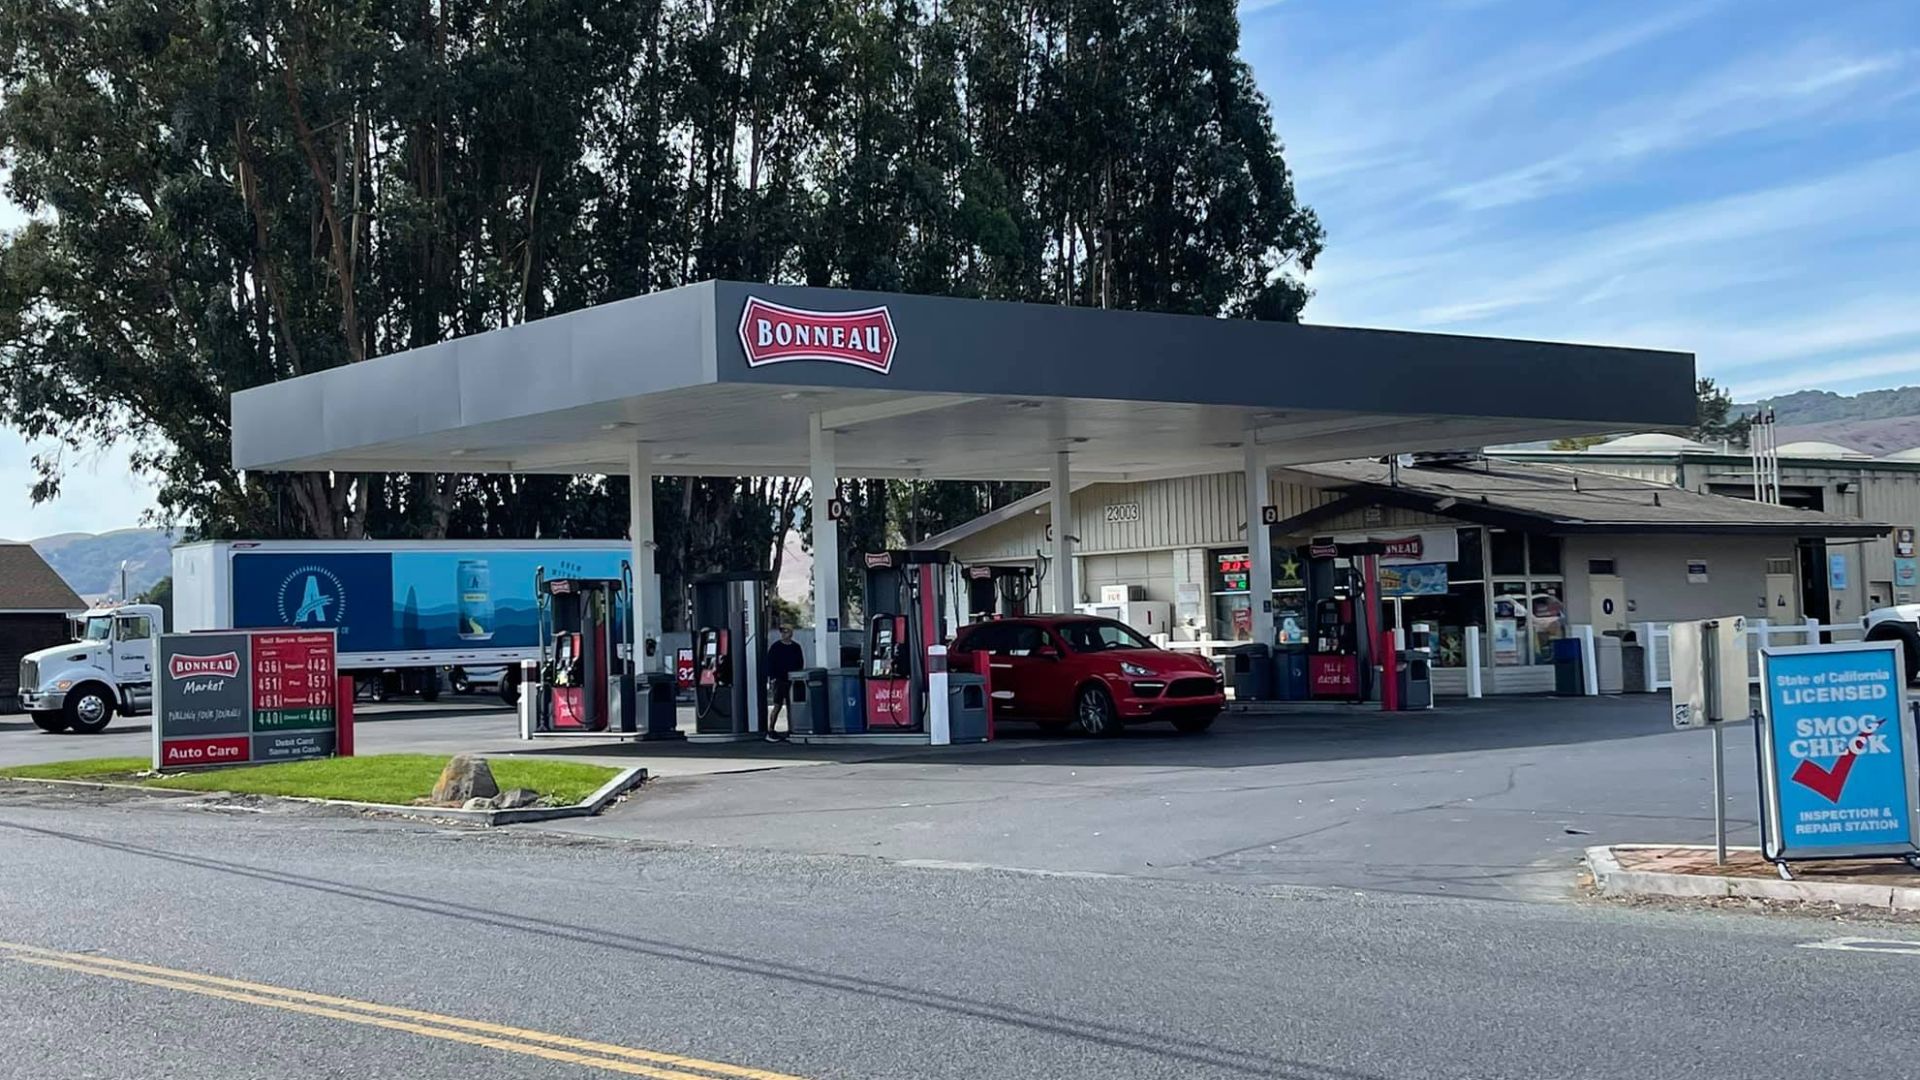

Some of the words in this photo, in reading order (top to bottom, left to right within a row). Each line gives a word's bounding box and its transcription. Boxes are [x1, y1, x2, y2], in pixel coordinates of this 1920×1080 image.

[757, 318, 881, 353] BONNEAU
[1107, 505, 1138, 521] 23003
[177, 660, 233, 672] BONNEAU
[1777, 674, 1811, 687] State
[1813, 673, 1826, 685] of
[1829, 669, 1890, 683] California
[183, 680, 224, 694] Market
[1782, 684, 1887, 705] LICENSED
[1796, 714, 1880, 737] SMOG
[275, 739, 295, 747] Debit
[296, 737, 315, 746] Card
[1789, 734, 1891, 758] CHECK
[169, 747, 203, 760] Auto
[207, 745, 239, 758] Care
[269, 748, 290, 756] Same
[302, 745, 321, 754] Cash
[1800, 808, 1880, 822] INSPECTION
[1882, 807, 1892, 818] &
[1795, 822, 1843, 835] REPAIR
[1844, 819, 1899, 832] STATION
